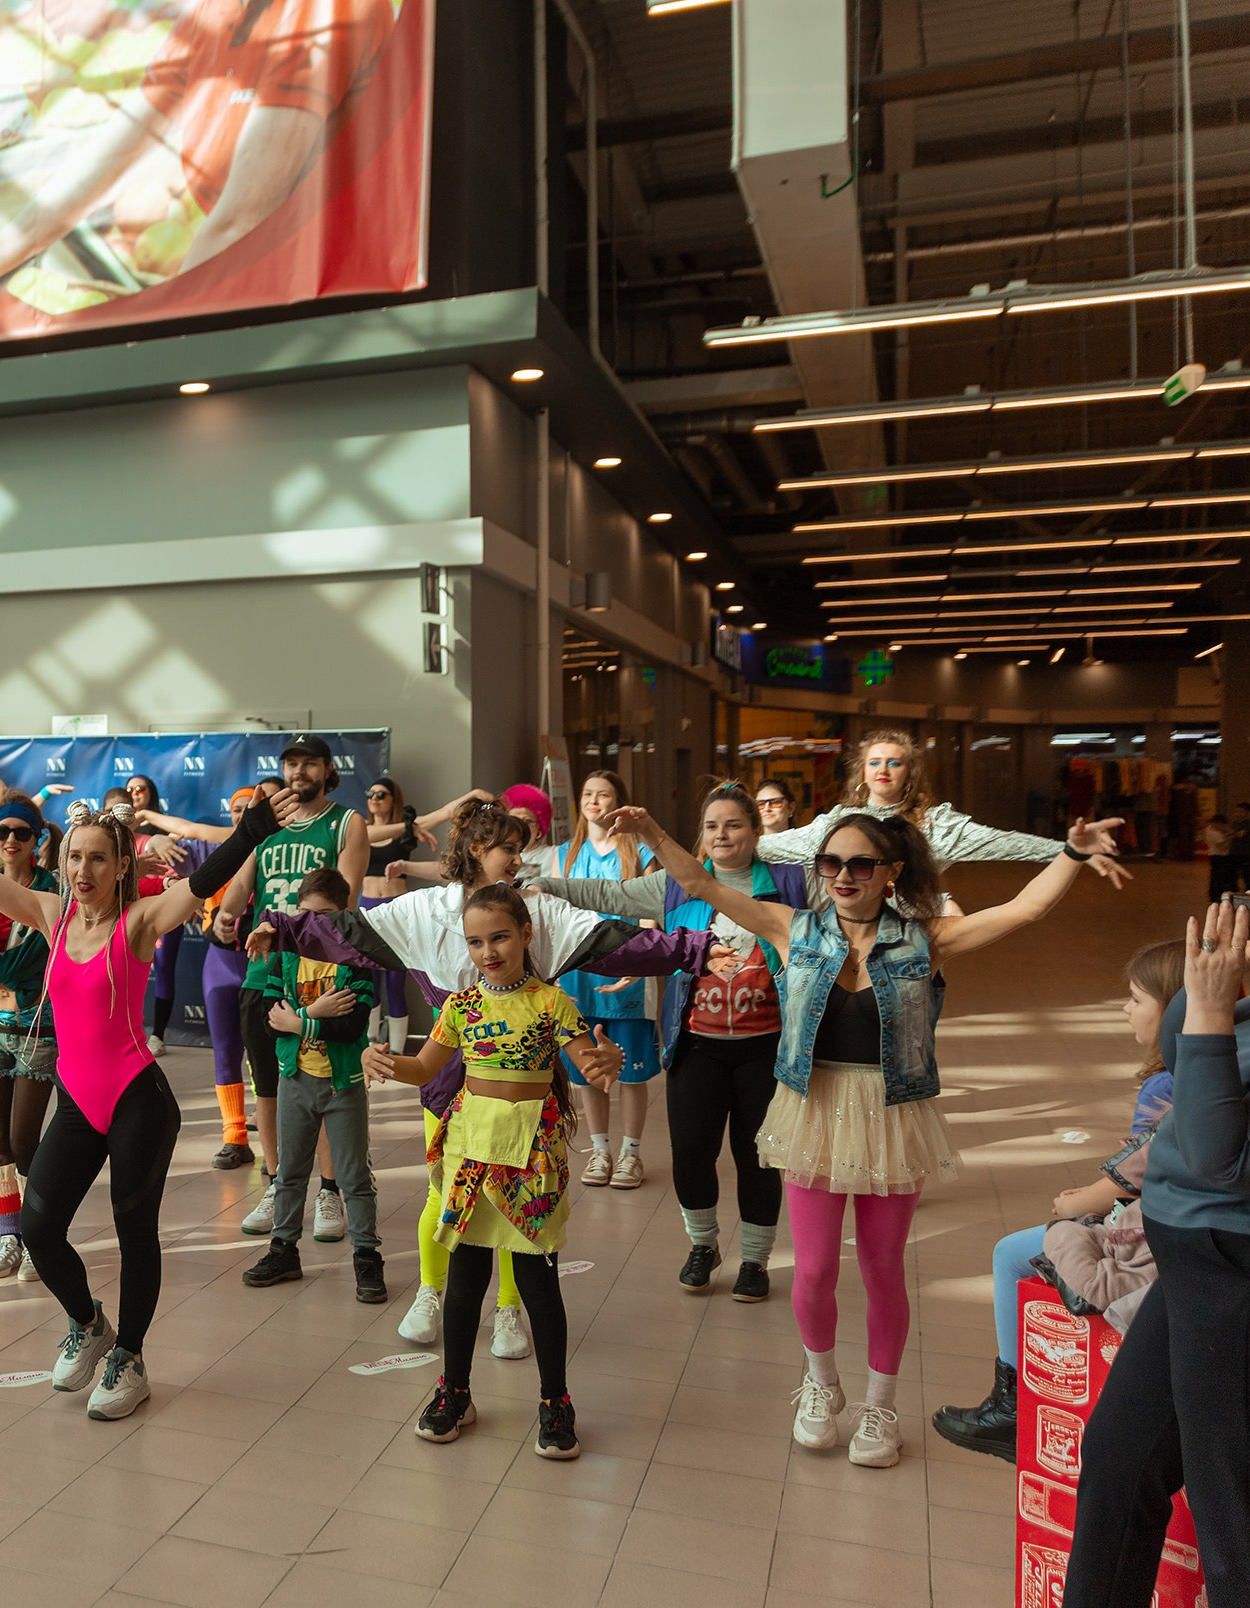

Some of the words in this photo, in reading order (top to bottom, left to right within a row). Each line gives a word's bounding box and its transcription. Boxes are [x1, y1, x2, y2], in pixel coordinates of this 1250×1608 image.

[114, 756, 135, 772] NN
[183, 755, 205, 771] NN
[257, 755, 278, 770] NN
[333, 755, 355, 769] NN
[261, 843, 326, 879] CELTICS
[462, 1019, 515, 1043] COOL
